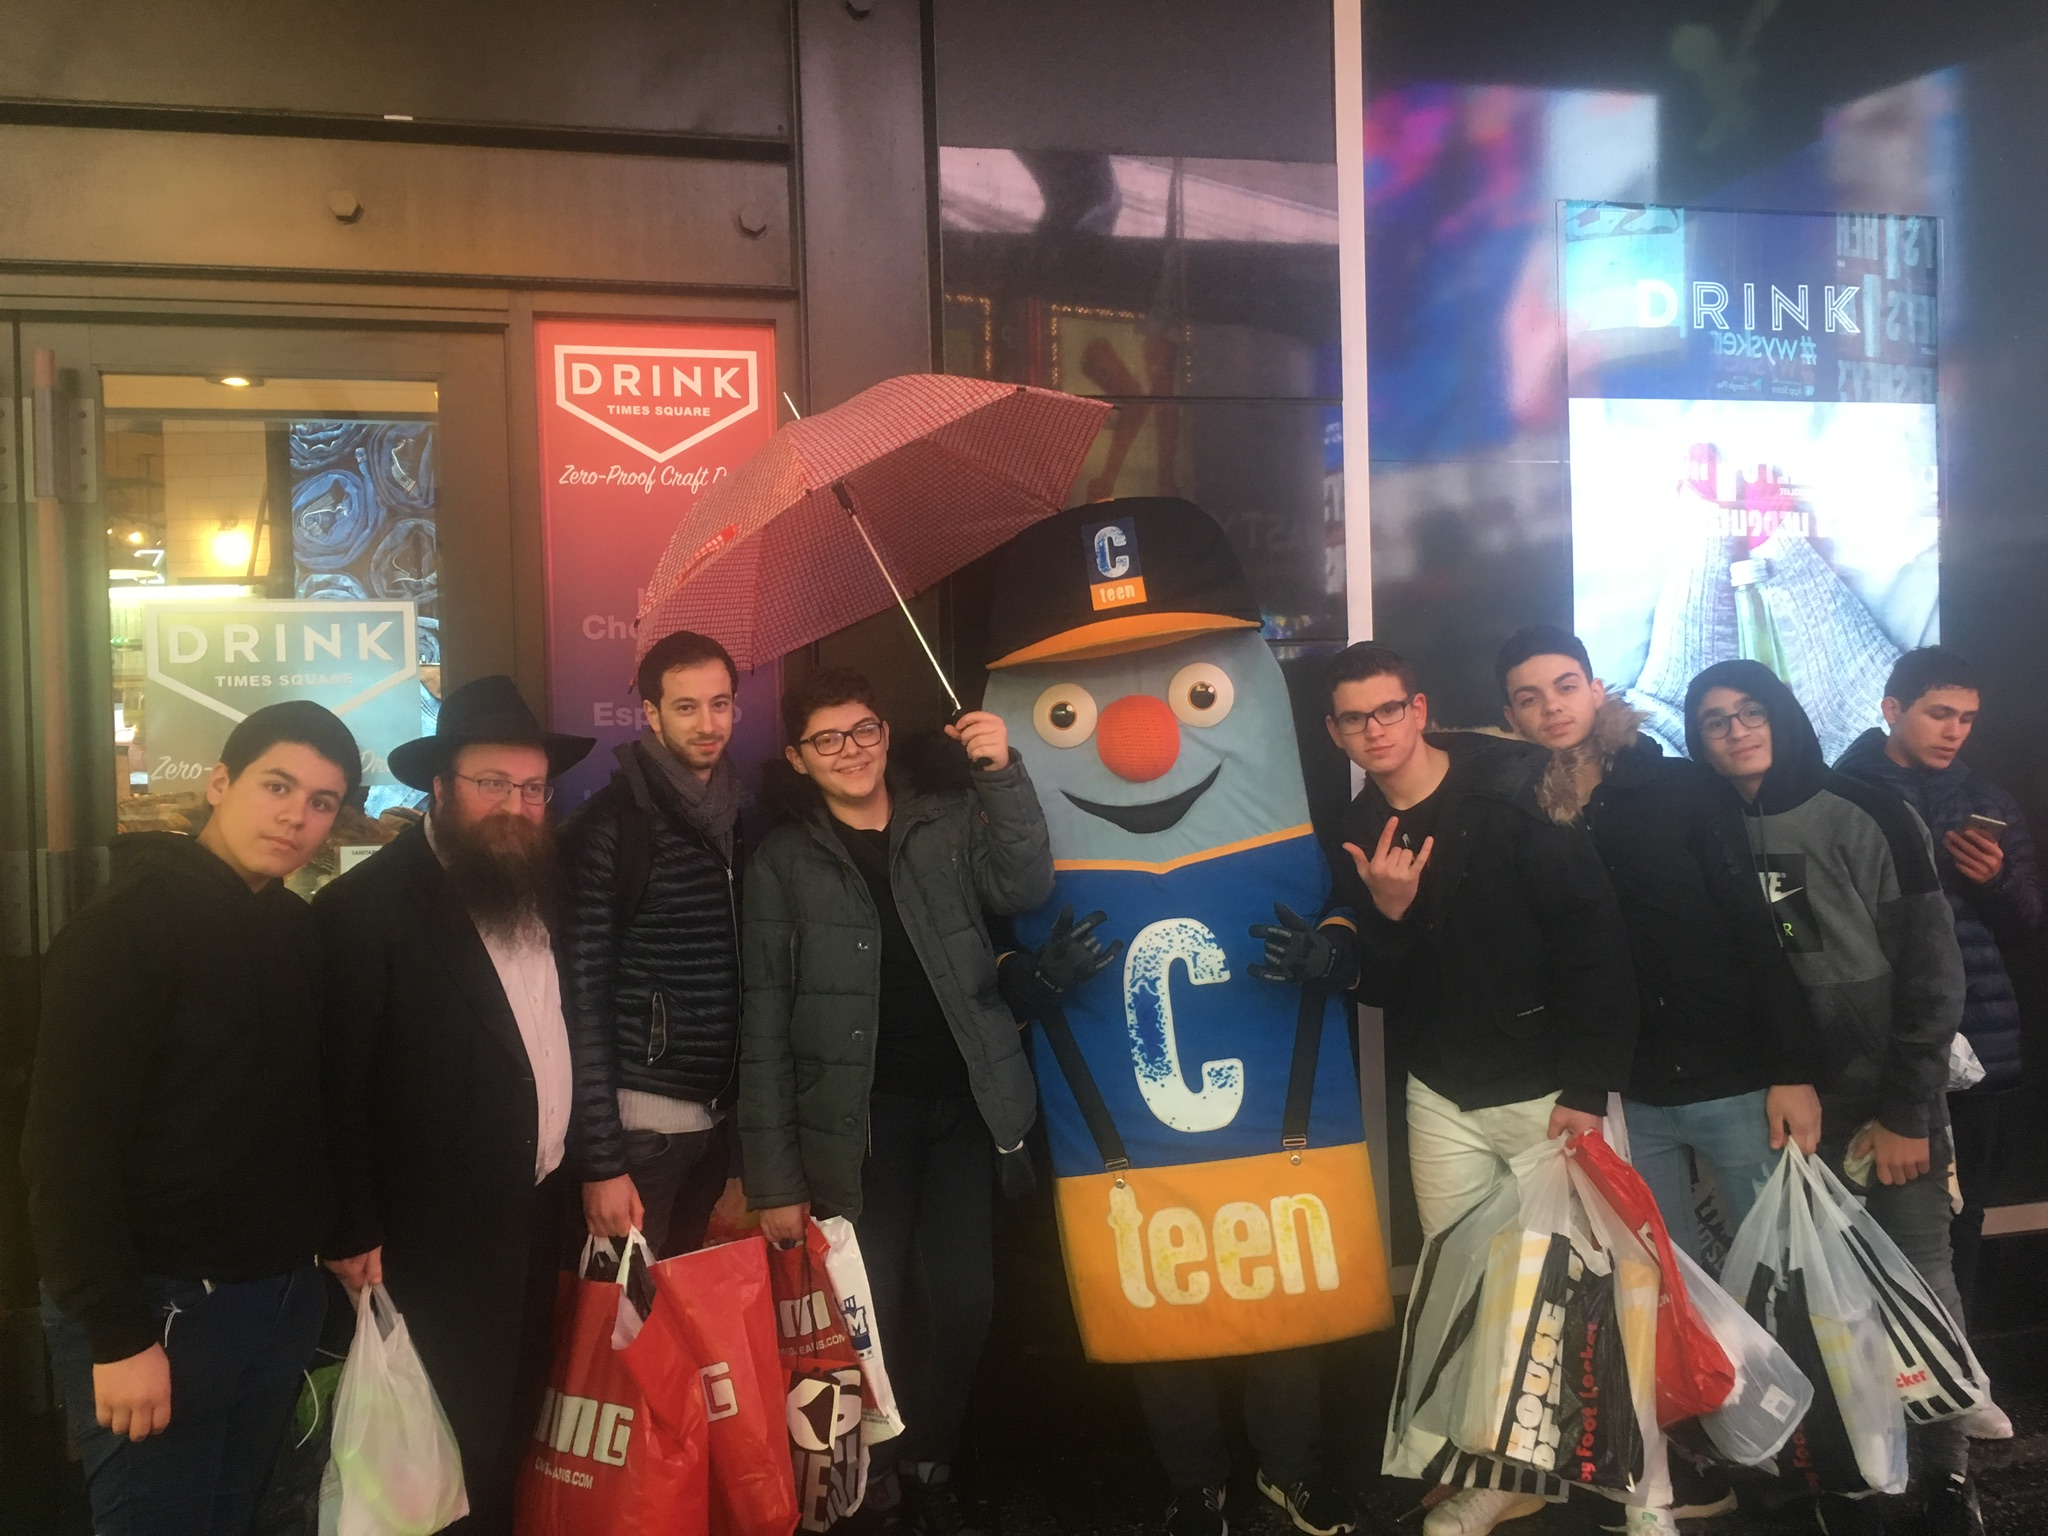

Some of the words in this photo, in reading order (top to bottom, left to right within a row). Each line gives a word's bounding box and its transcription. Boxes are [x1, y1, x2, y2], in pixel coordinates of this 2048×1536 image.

[1636, 278, 1861, 333] DRINK
[571, 363, 742, 398] DRINK
[607, 404, 650, 416] TIMES
[654, 405, 711, 417] SQUARE
[559, 464, 656, 494] Zero-Proof
[660, 466, 709, 494] Craft
[1094, 525, 1129, 579] C
[1100, 583, 1136, 603] teen
[167, 621, 395, 664] DRINK
[214, 674, 272, 687] TIMES
[278, 672, 354, 687] SQUARE
[150, 755, 213, 781] Zero-
[1123, 917, 1244, 1133] C
[1106, 1184, 1340, 1309] teen
[1506, 1300, 1567, 1464] HOUSE
[1896, 1370, 1927, 1388] cker
[1575, 1407, 1598, 1457] Foot
[1578, 1462, 1597, 1482] by
